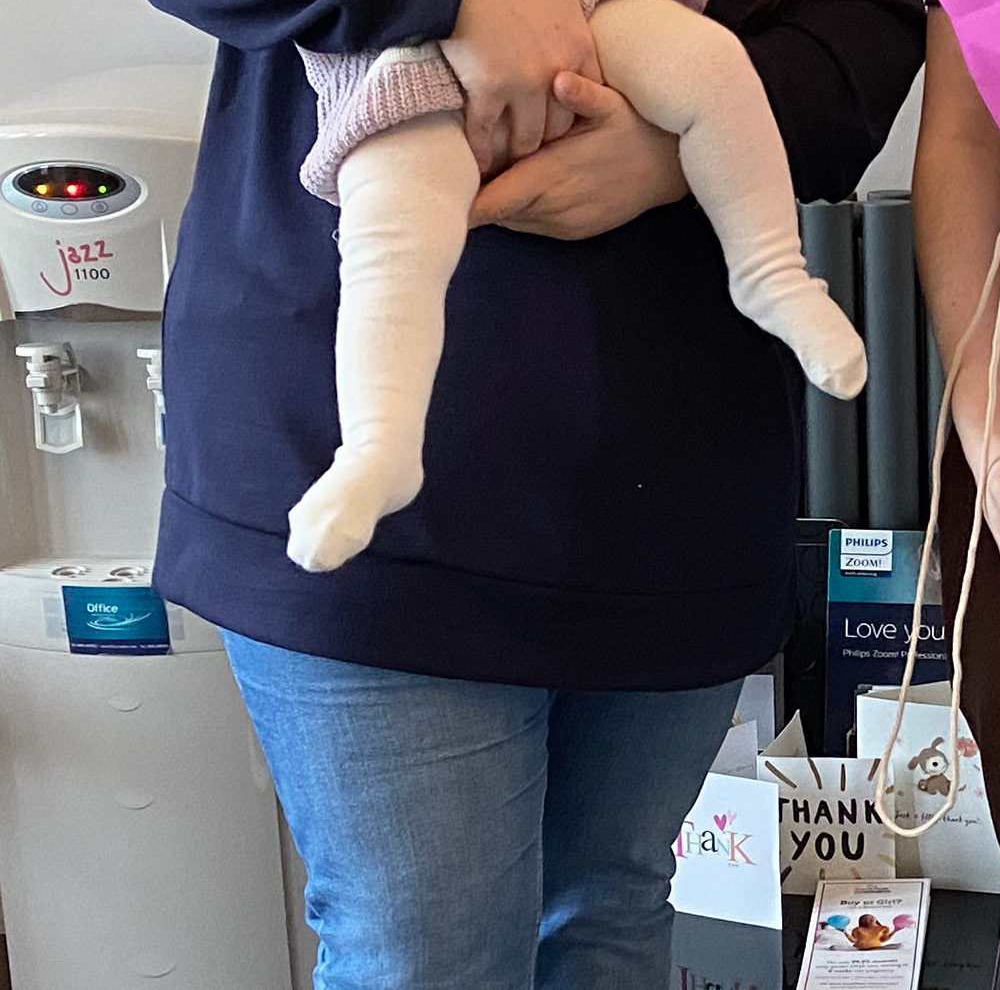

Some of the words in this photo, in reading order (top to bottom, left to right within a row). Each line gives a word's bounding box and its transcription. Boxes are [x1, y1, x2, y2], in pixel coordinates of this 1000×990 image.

[40, 239, 113, 296] jazz
[75, 268, 110, 280] 1100
[845, 538, 888, 547] PHILIPS
[86, 603, 118, 613] Office
[845, 618, 897, 639] Love
[842, 649, 871, 659] Philips
[779, 798, 884, 824] THANK
[790, 830, 864, 860] YOU
